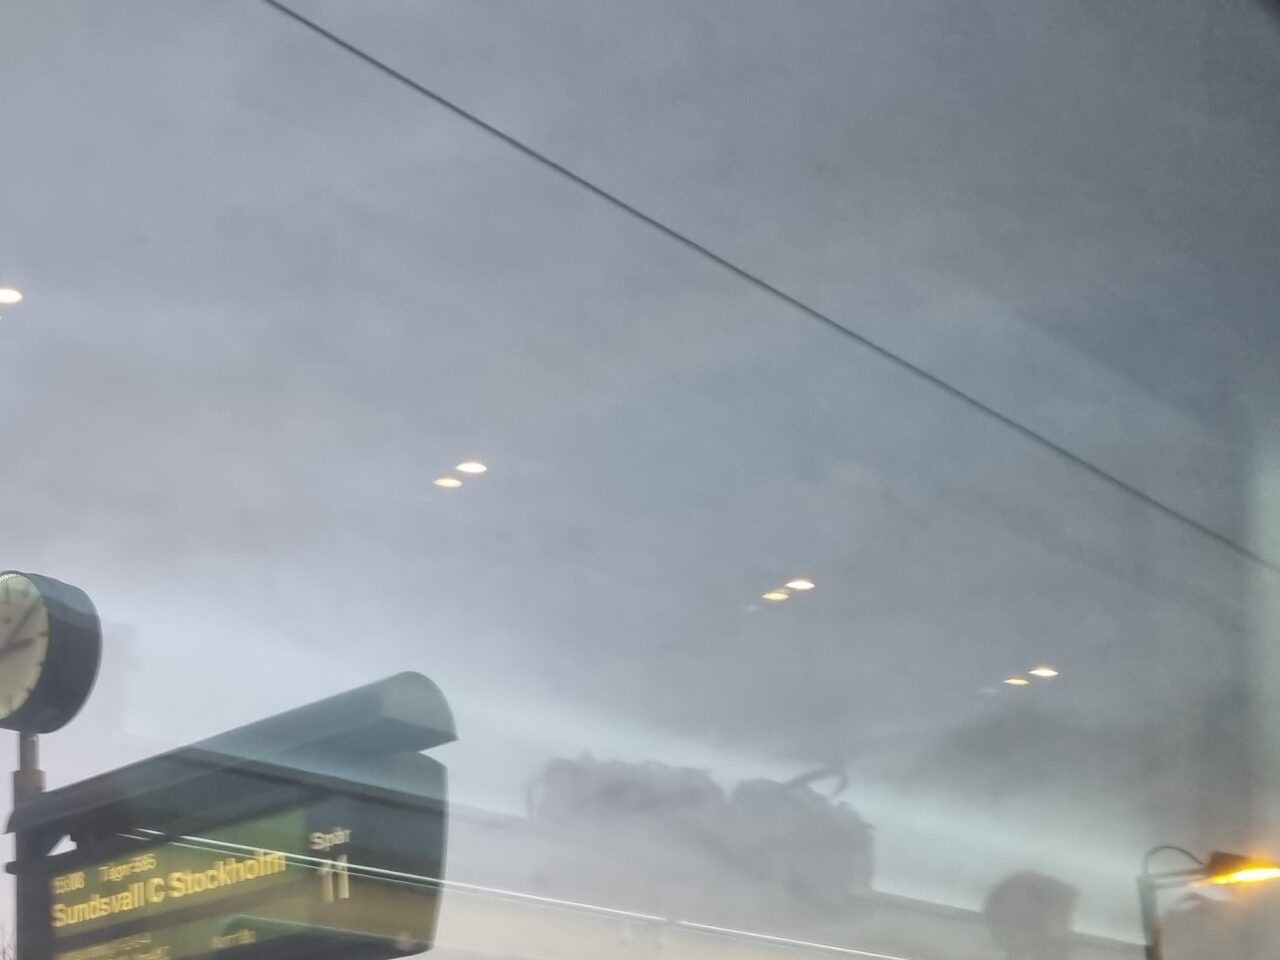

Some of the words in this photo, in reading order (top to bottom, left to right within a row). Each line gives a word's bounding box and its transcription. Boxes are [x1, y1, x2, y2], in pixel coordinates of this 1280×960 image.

[52, 882, 145, 927] Sundsvall
[147, 877, 166, 903] C
[167, 851, 287, 897] Stockholm
[319, 854, 350, 902] 11
